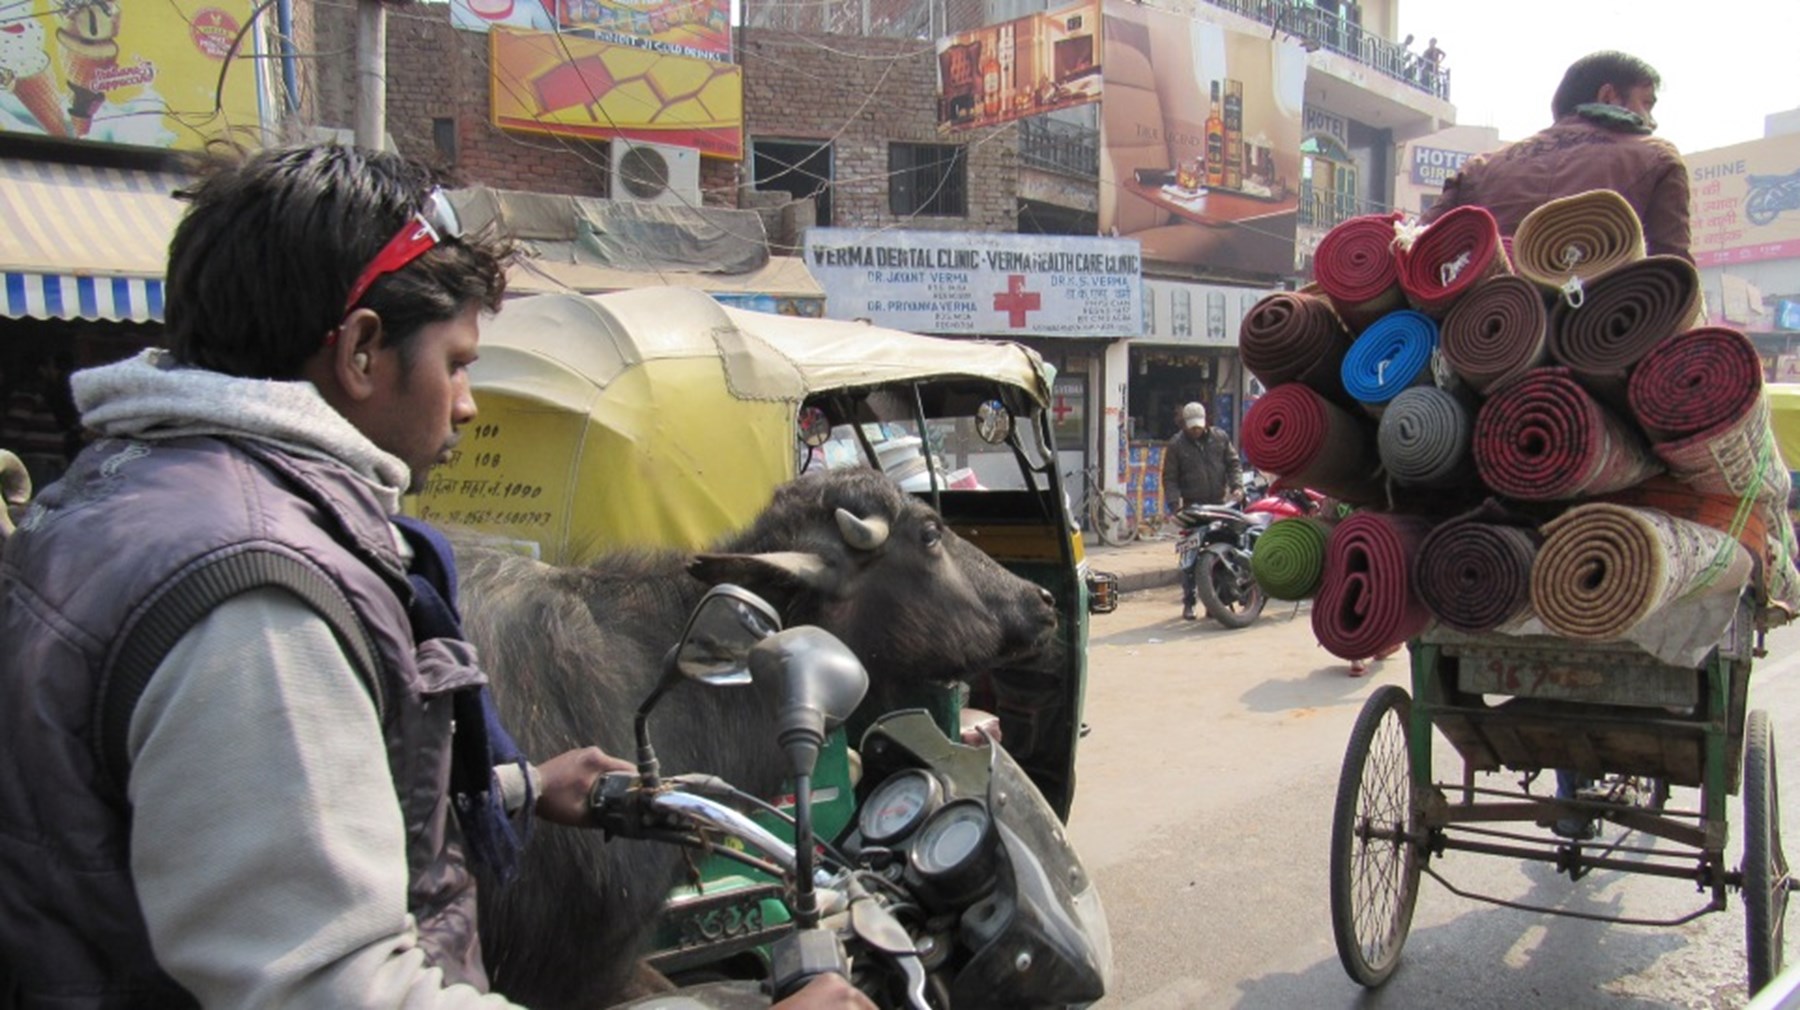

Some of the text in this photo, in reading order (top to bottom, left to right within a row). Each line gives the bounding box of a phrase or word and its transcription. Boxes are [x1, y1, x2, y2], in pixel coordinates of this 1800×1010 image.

[1305, 107, 1346, 145] HOTEL
[1416, 149, 1474, 169] HOTE
[1695, 161, 1745, 180] SHINE
[812, 246, 873, 268] VERMA
[876, 248, 934, 268] DENTAL
[937, 249, 979, 269] CLINIC
[986, 251, 1031, 272] VERMA
[1075, 253, 1103, 273] CARE
[930, 272, 969, 284] VERMA
[940, 302, 977, 313] VERMA
